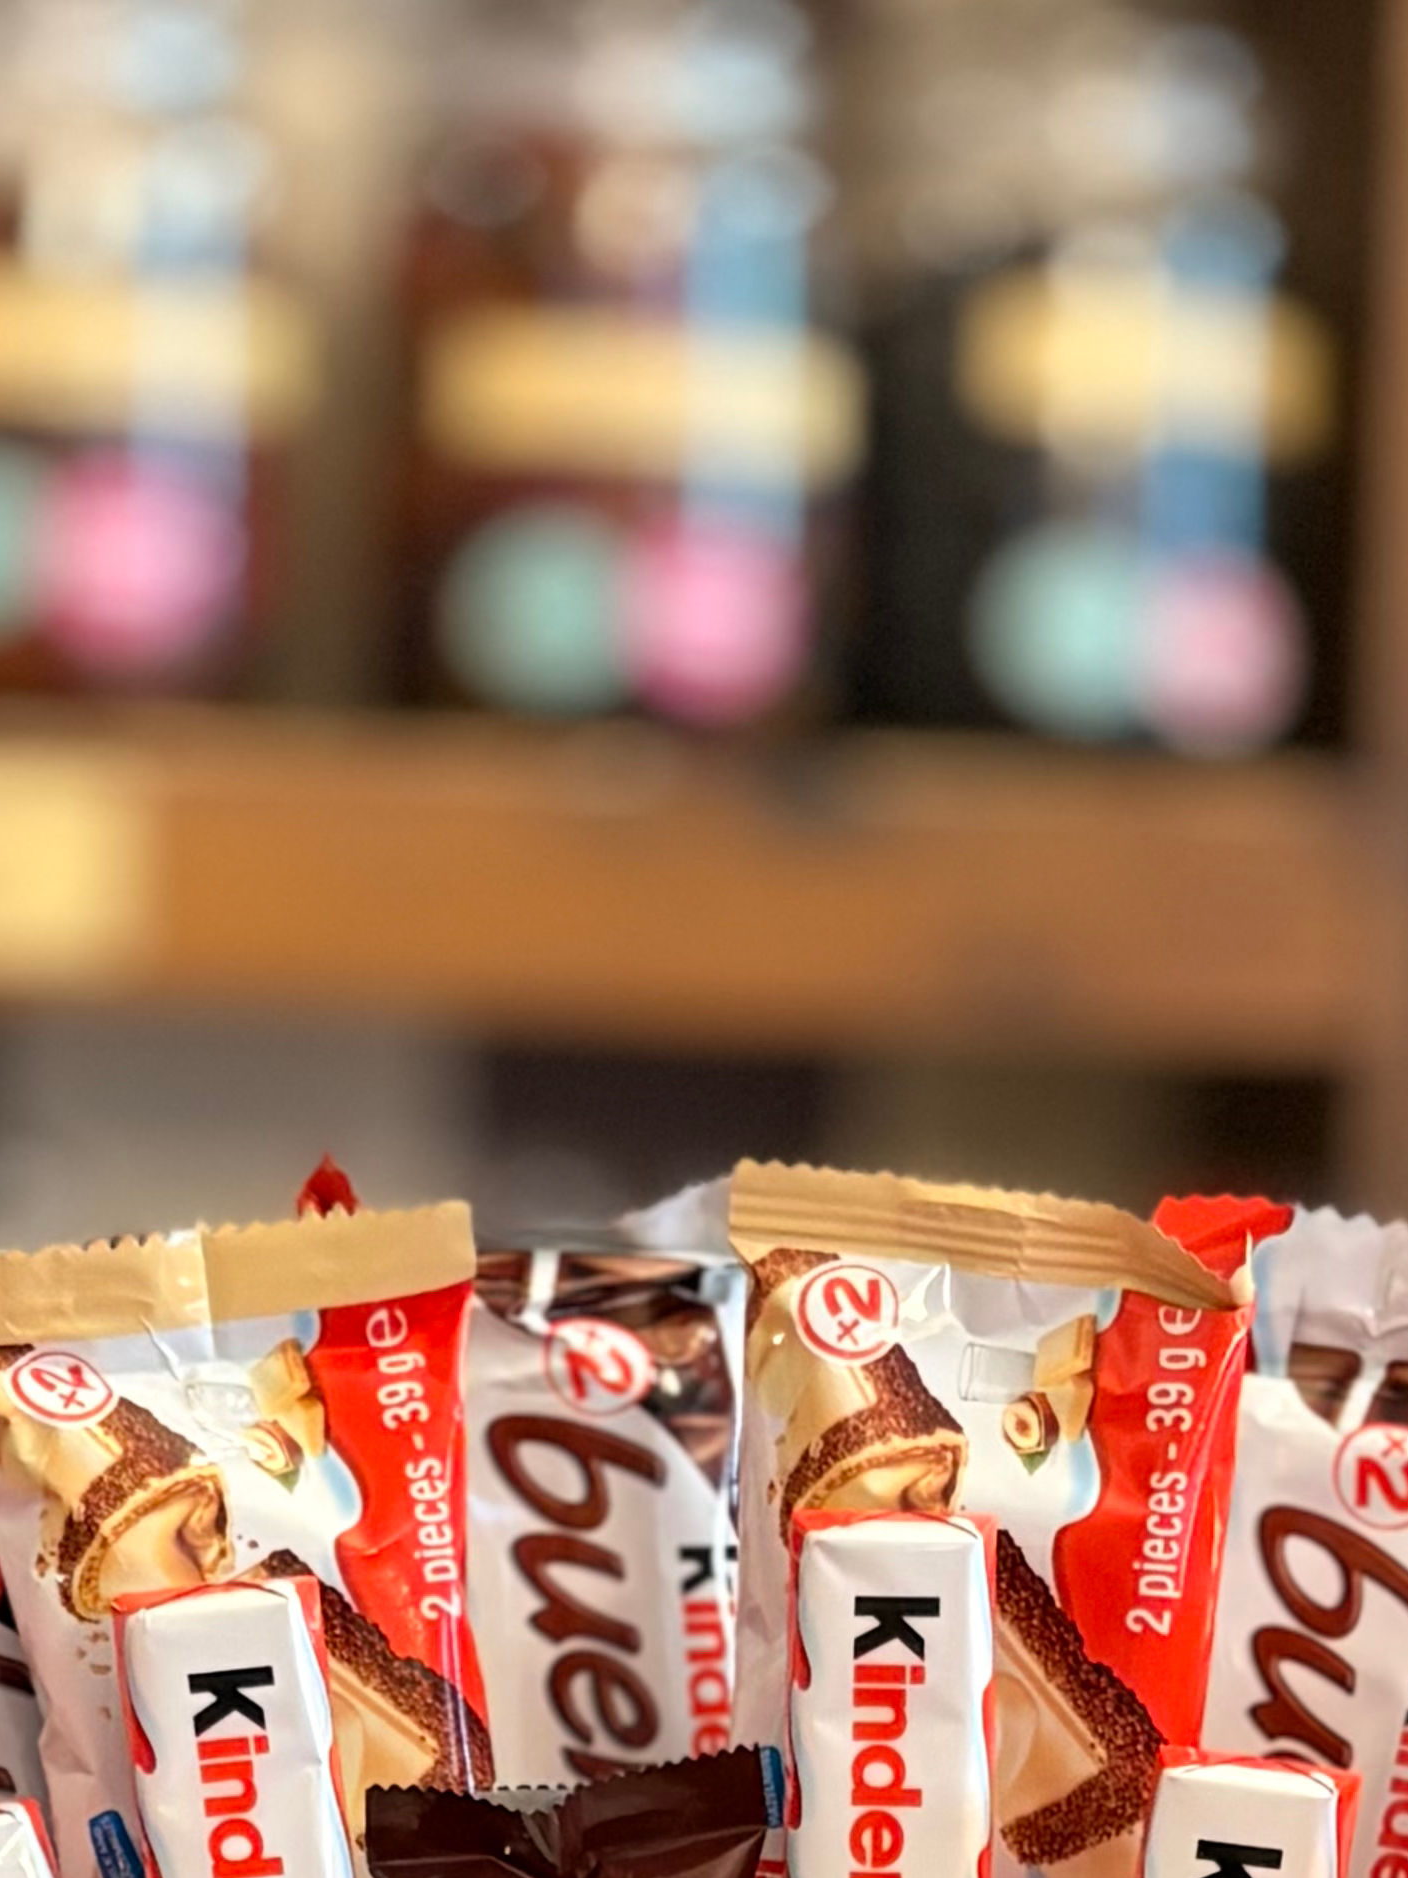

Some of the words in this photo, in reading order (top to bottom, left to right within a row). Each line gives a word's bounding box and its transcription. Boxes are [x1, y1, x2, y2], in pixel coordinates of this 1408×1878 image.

[377, 1380, 430, 1431] 39
[1146, 1381, 1195, 1433] 39
[405, 1456, 459, 1584] pieces
[1132, 1470, 1188, 1600] pieces
[421, 1593, 462, 1621] 2
[1125, 1608, 1172, 1637] 2
